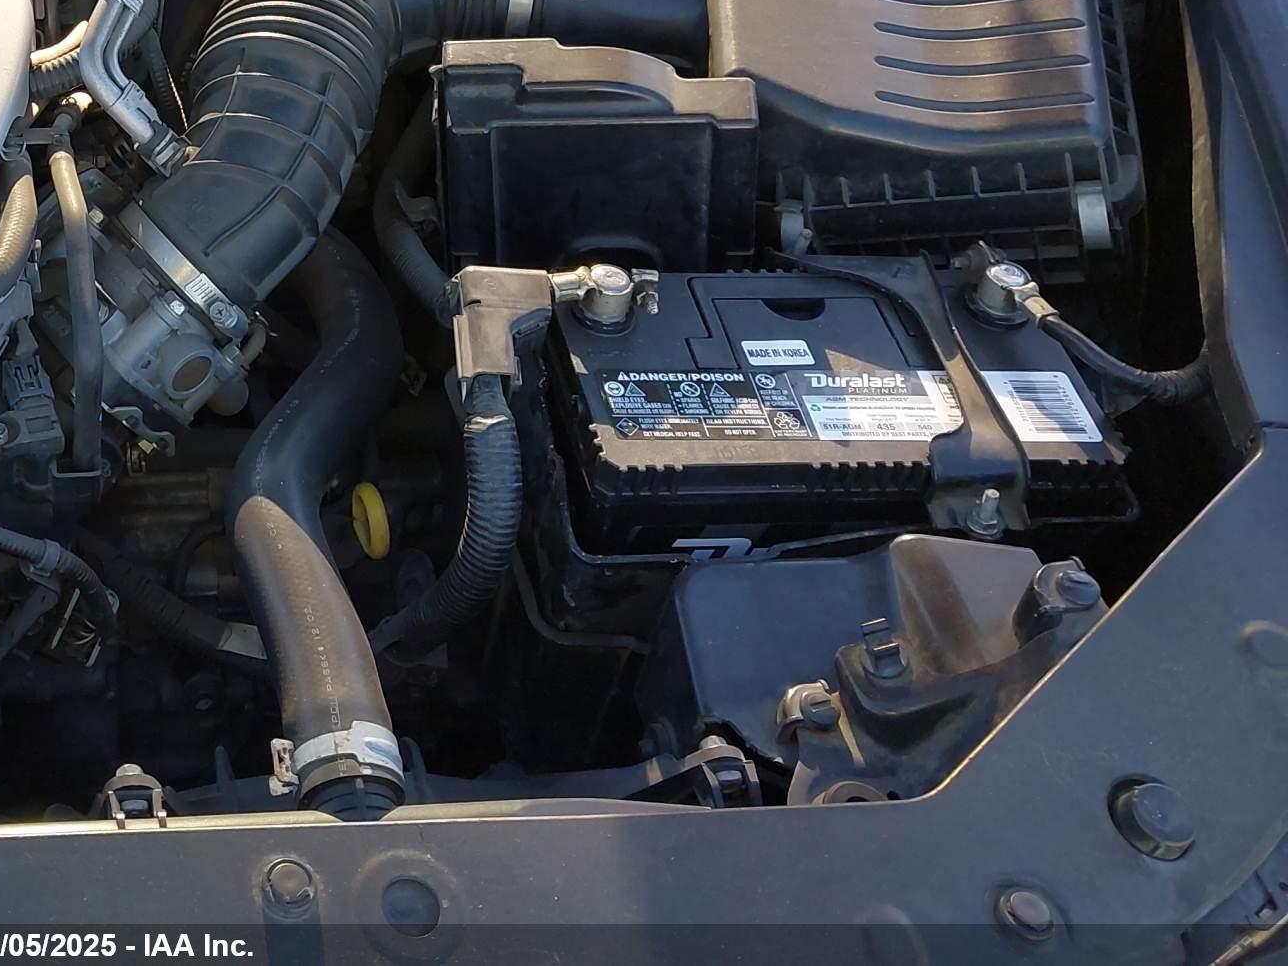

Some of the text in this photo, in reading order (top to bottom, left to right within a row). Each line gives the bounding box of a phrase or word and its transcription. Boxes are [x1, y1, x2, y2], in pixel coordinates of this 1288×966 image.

[746, 347, 809, 358] MADE IN KOREA
[630, 372, 745, 382] DANGER/POISON
[804, 373, 906, 388] Duralast
[823, 422, 862, 431] 51R-AGM
[876, 423, 896, 431] 435
